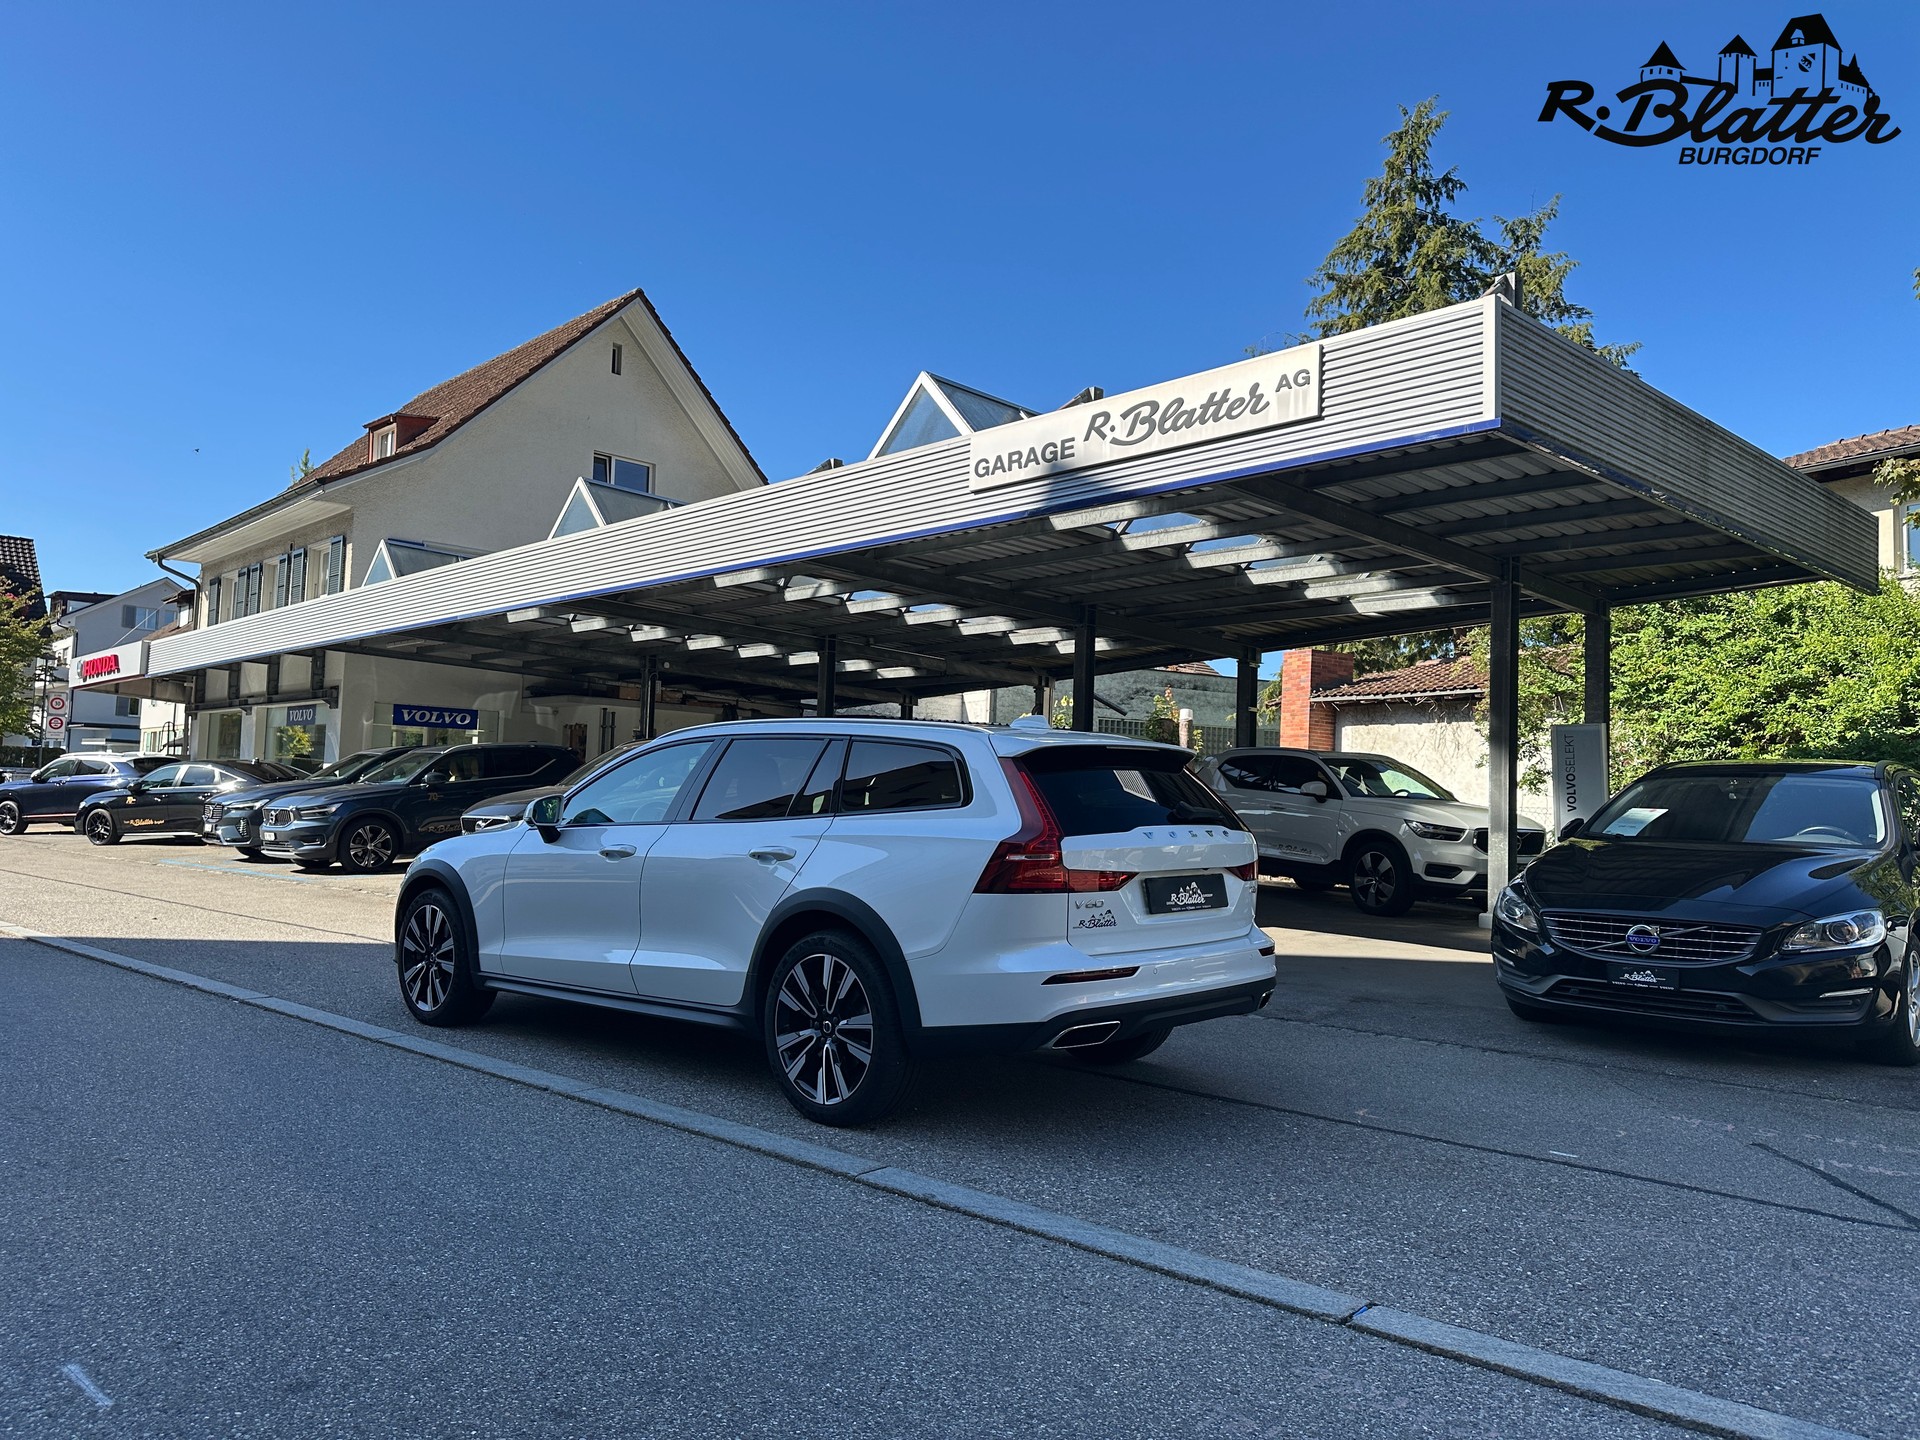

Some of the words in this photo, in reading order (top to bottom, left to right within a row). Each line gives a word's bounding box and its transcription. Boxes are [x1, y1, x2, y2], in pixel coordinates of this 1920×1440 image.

[974, 437, 1076, 478] GARAGE
[1275, 368, 1311, 393] AG
[83, 655, 118, 677] HONDA
[289, 708, 313, 722] VOLVO
[401, 709, 471, 725] VOLVO
[1075, 899, 1105, 909] V60
[1628, 936, 1657, 944] VOLVO
